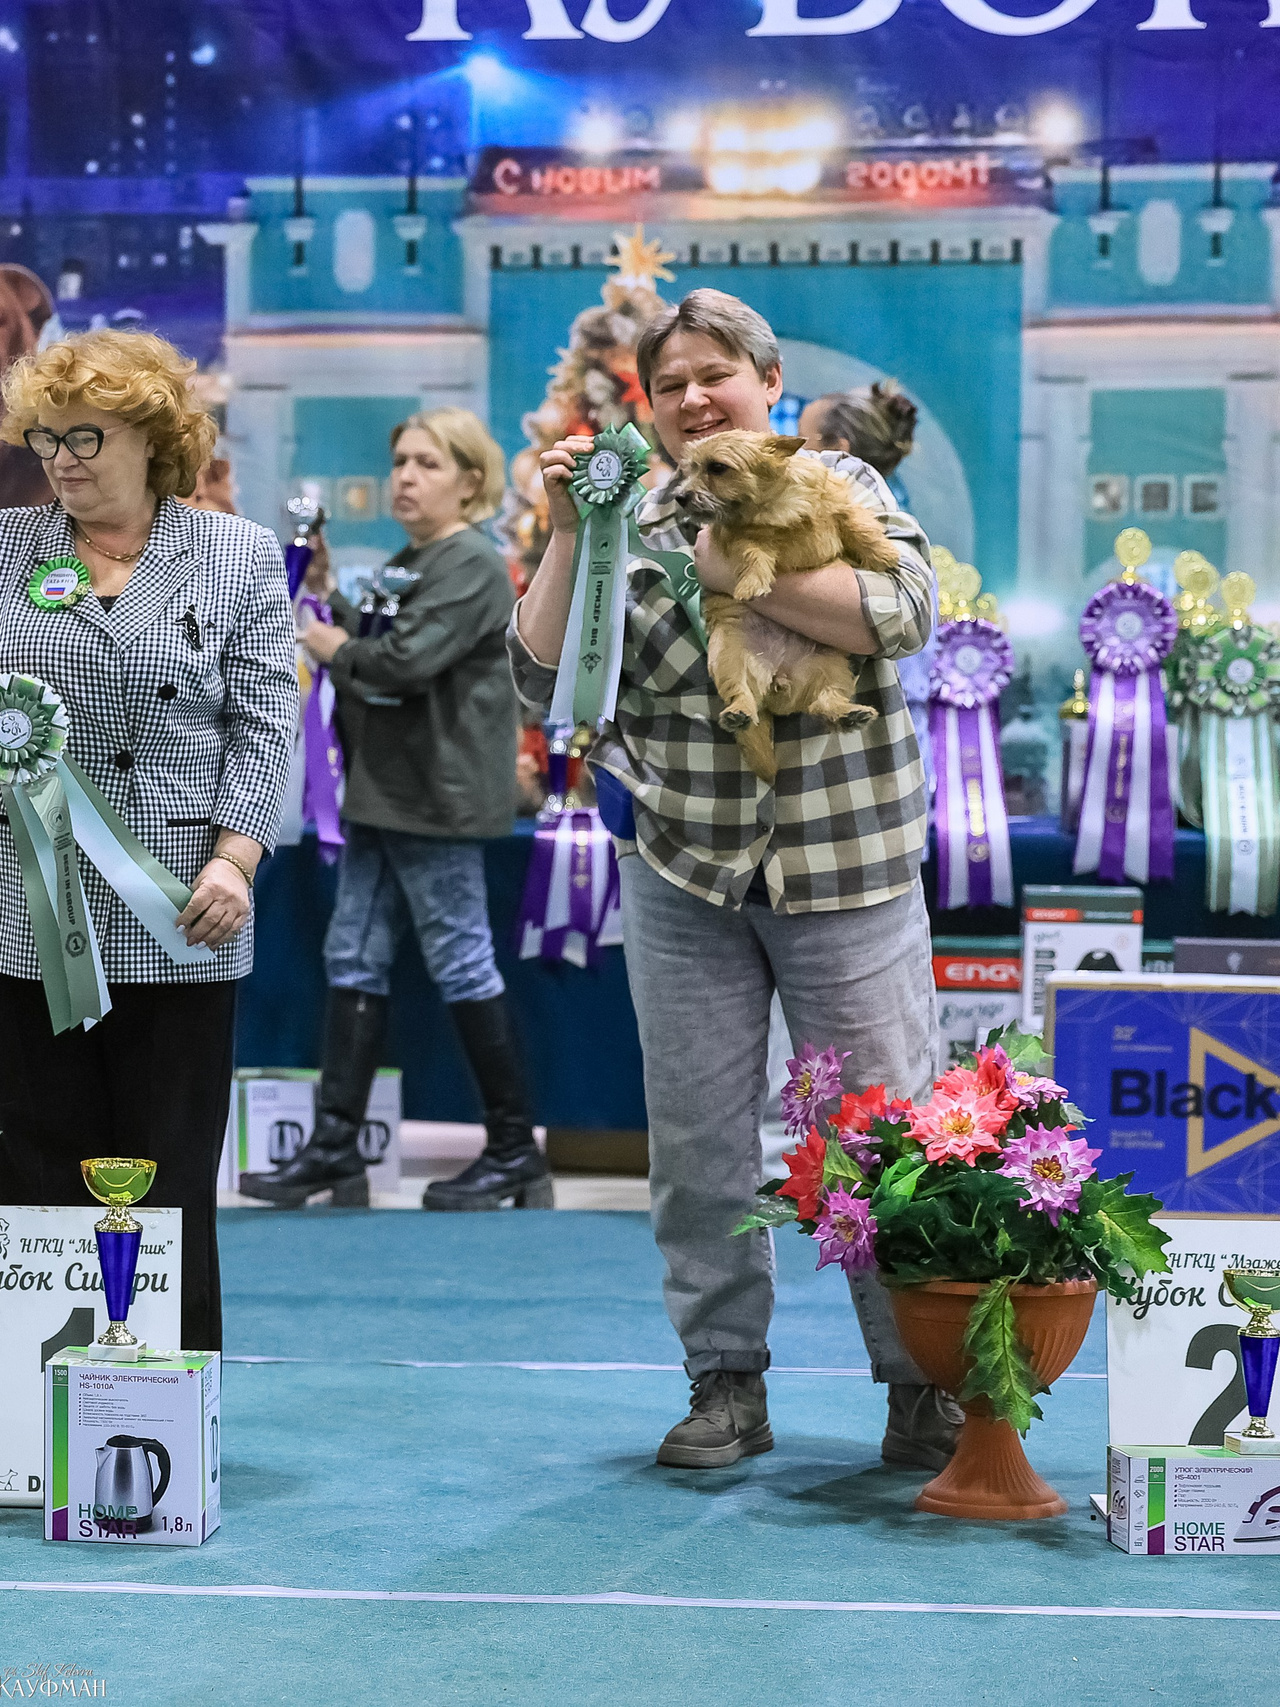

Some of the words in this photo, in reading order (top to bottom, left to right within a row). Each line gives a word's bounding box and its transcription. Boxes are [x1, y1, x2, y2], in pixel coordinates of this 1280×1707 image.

[62, 853, 71, 878] BEST
[64, 879, 72, 890] IN
[66, 891, 76, 926] GROUP
[1110, 1068, 1280, 1119] Black
[19, 1237, 64, 1257] НГКЦ
[1169, 1252, 1216, 1272] НГКЦ
[64, 1262, 169, 1305] Сири
[53, 1368, 68, 1376] 1500
[79, 1373, 111, 1382] ЧАЙНИК
[112, 1374, 179, 1385] ЭЛЕКТРИЧЕСКИЙ
[79, 1382, 115, 1390] HS-1010A
[1195, 1466, 1253, 1474] ЭЛЕКТРИЧЕСКИЙ
[78, 1503, 138, 1520] HOME
[78, 1520, 138, 1540] STAR
[1174, 1522, 1226, 1536] HOME
[1174, 1536, 1226, 1552] STAR
